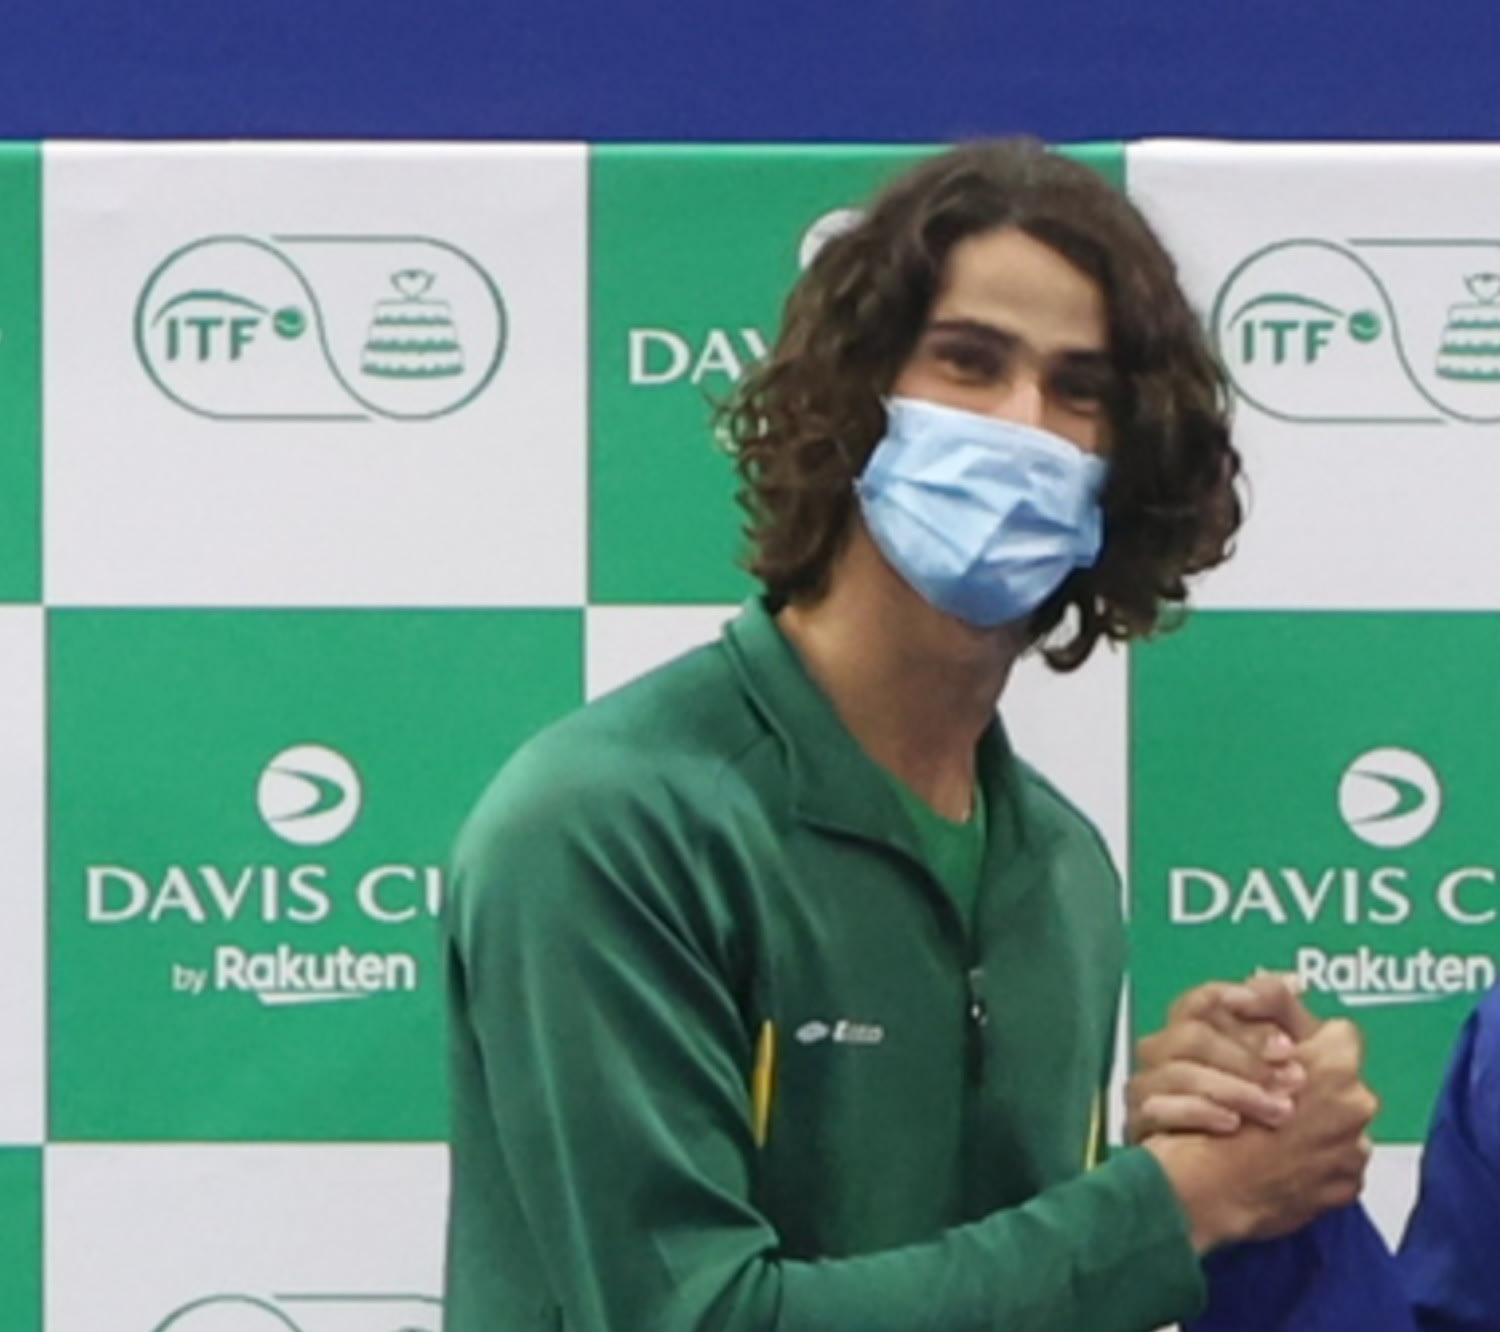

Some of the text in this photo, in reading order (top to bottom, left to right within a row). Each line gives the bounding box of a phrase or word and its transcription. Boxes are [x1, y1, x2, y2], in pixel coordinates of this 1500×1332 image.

[165, 316, 262, 362] ITF
[1241, 318, 1336, 365] ITF
[87, 865, 330, 922] DAVIS
[1169, 867, 1411, 924] DAVIS
[172, 944, 416, 995] by Rakuten
[1297, 946, 1497, 992] Rakuten
